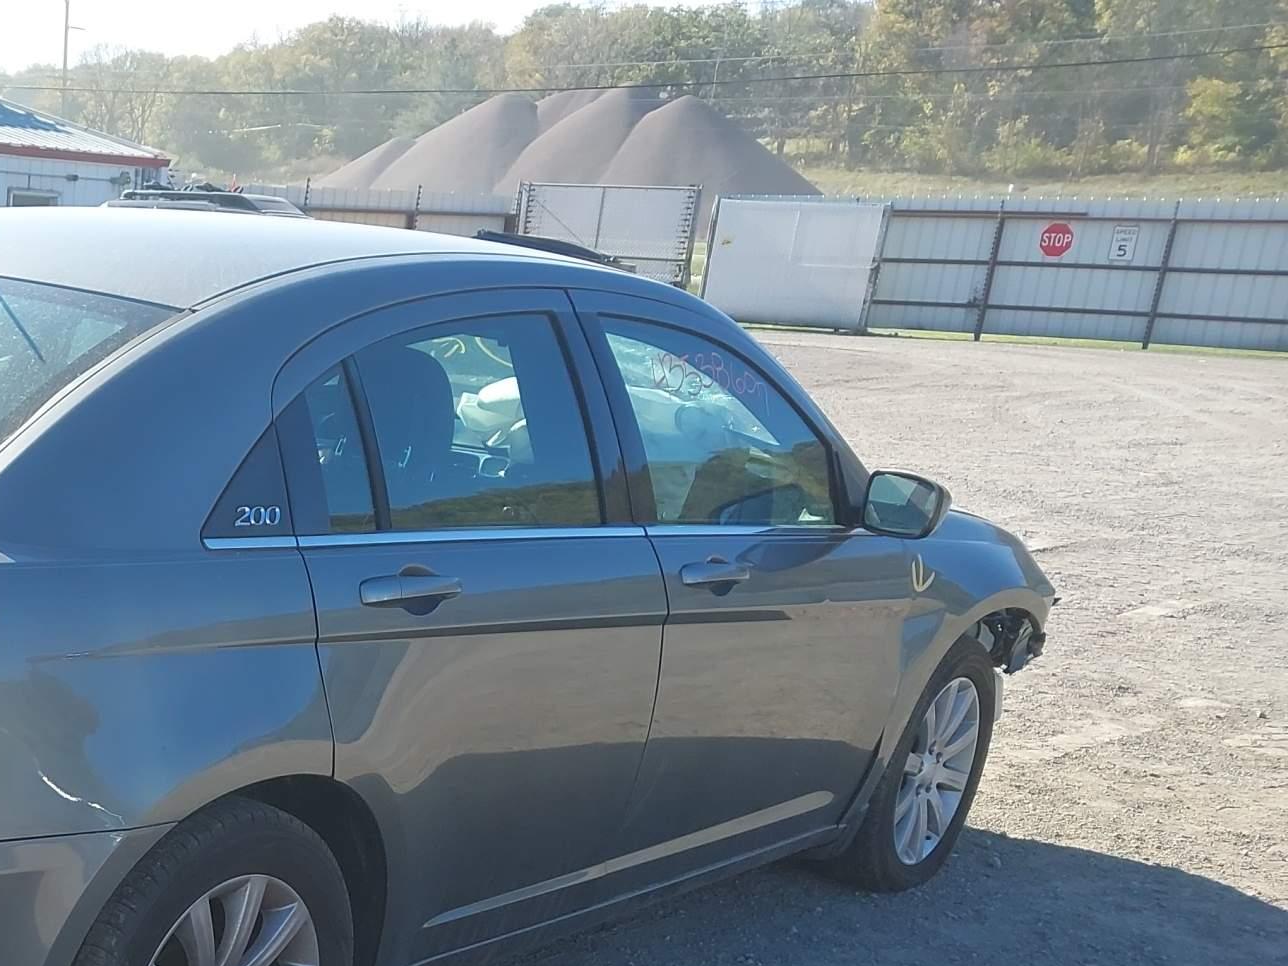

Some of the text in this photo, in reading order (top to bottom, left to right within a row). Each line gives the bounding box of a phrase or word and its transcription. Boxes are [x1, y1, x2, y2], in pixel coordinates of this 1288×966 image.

[1041, 233, 1072, 247] STOP
[1116, 244, 1128, 257] 5
[234, 506, 281, 527] 200
